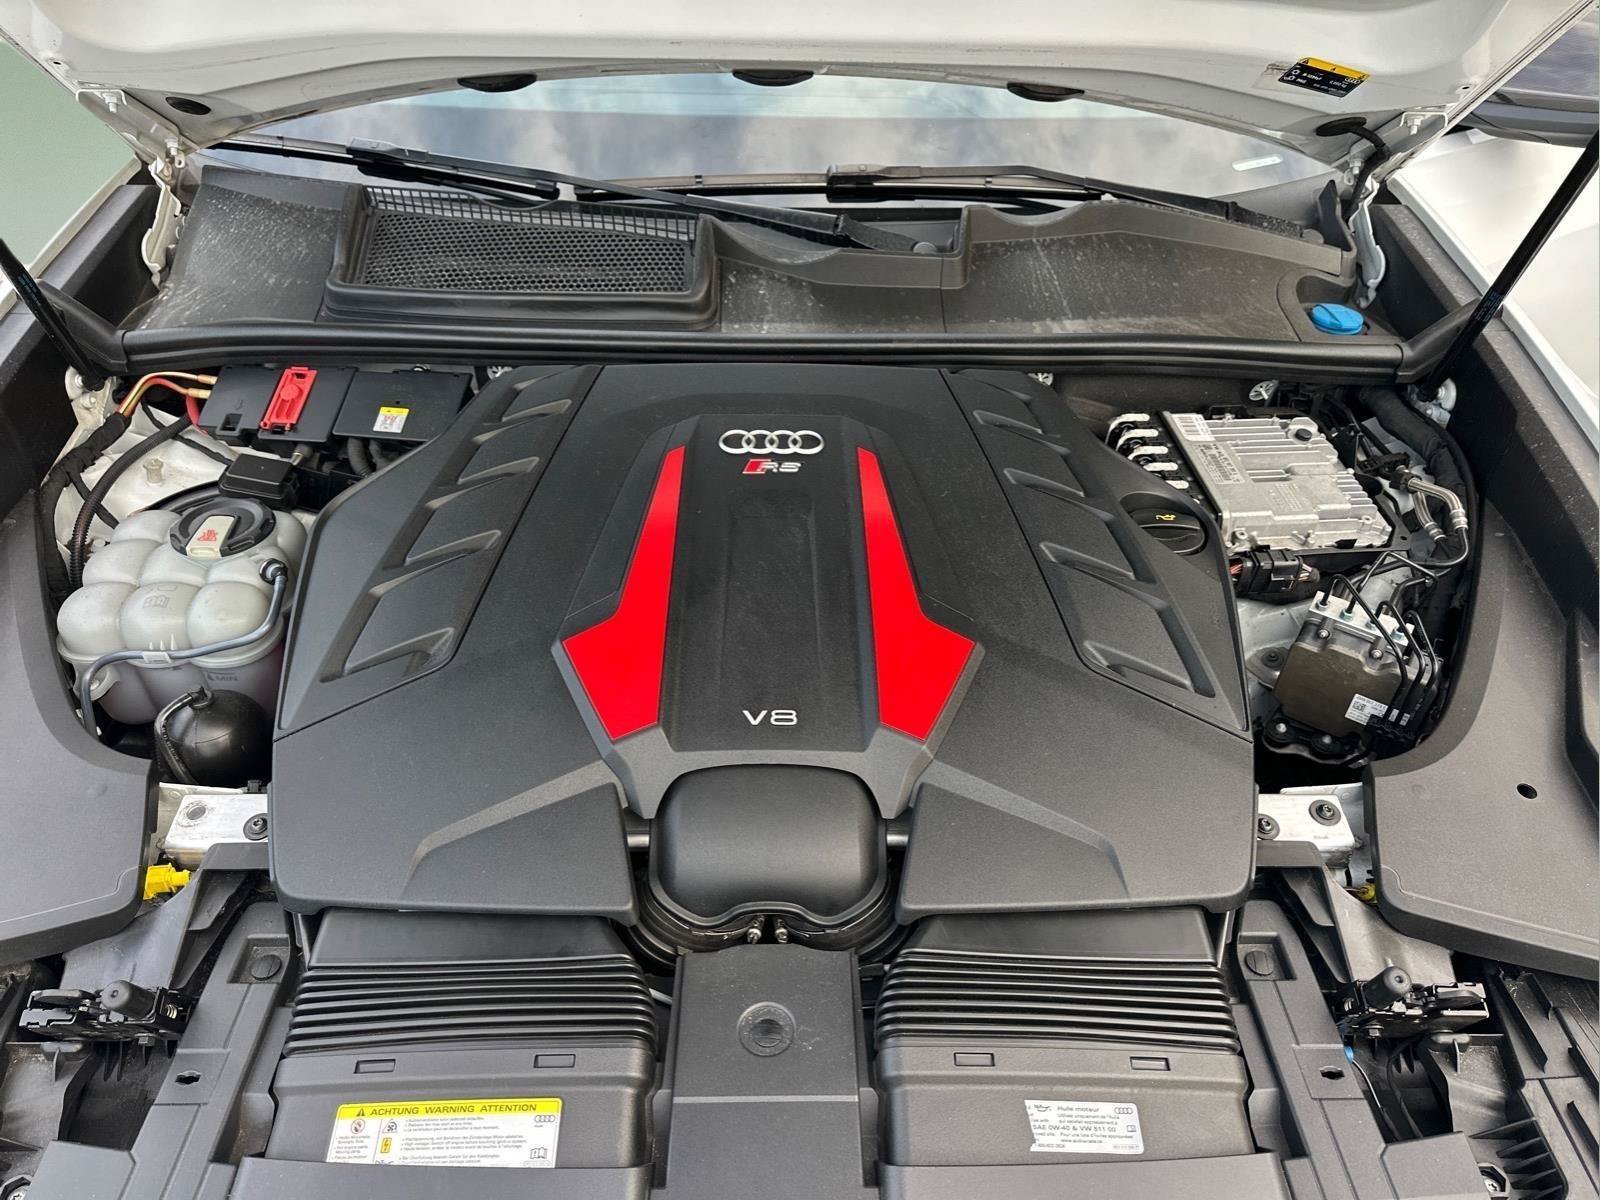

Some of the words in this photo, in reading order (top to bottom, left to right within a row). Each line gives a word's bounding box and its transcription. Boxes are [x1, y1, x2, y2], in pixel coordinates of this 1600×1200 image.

[742, 459, 801, 474] RS
[742, 710, 798, 725] V8
[370, 1107, 419, 1116] ACHTUNG
[425, 1105, 474, 1114] WARNING
[480, 1104, 537, 1112] ATTENTION
